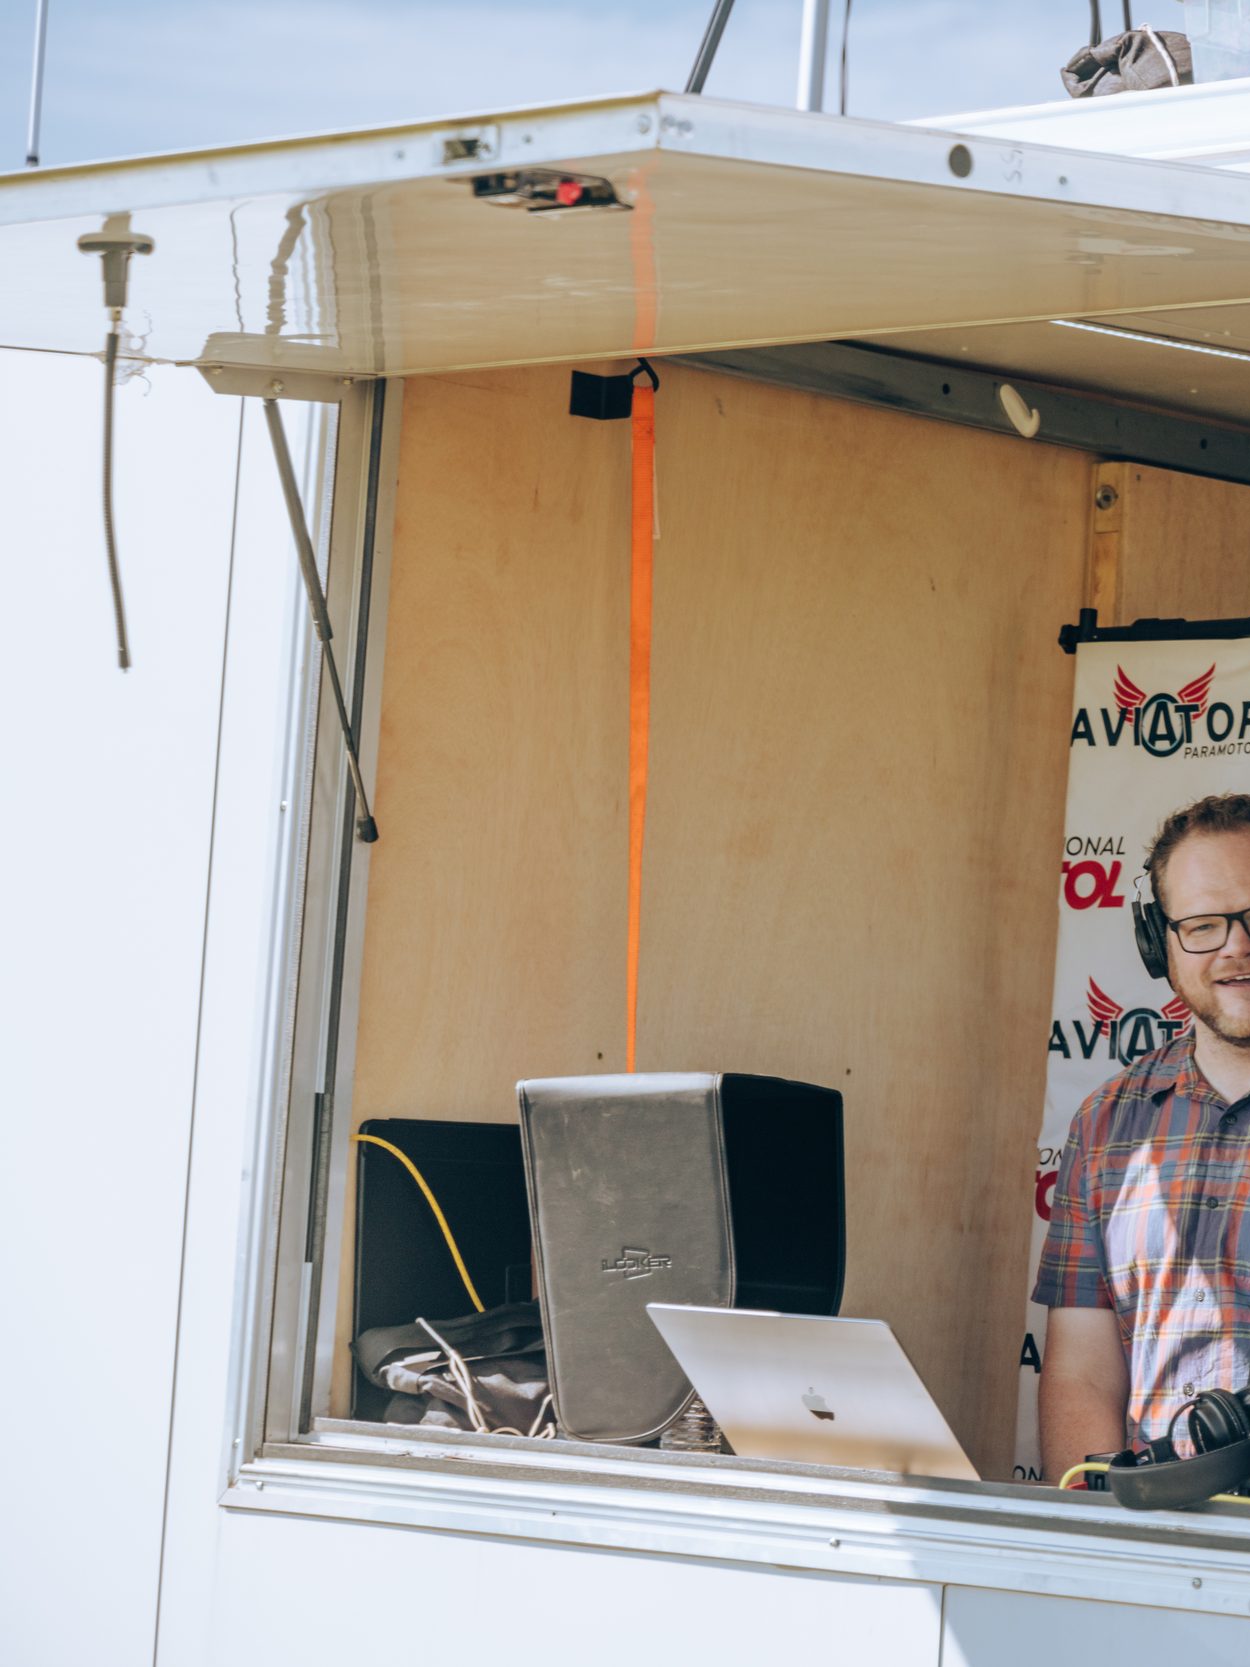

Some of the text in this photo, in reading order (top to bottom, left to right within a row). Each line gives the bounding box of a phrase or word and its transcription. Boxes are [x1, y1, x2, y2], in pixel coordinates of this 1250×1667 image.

[1064, 836, 1126, 856] ONAL
[1061, 860, 1125, 910] OL
[1048, 1010, 1184, 1063] AVIAT
